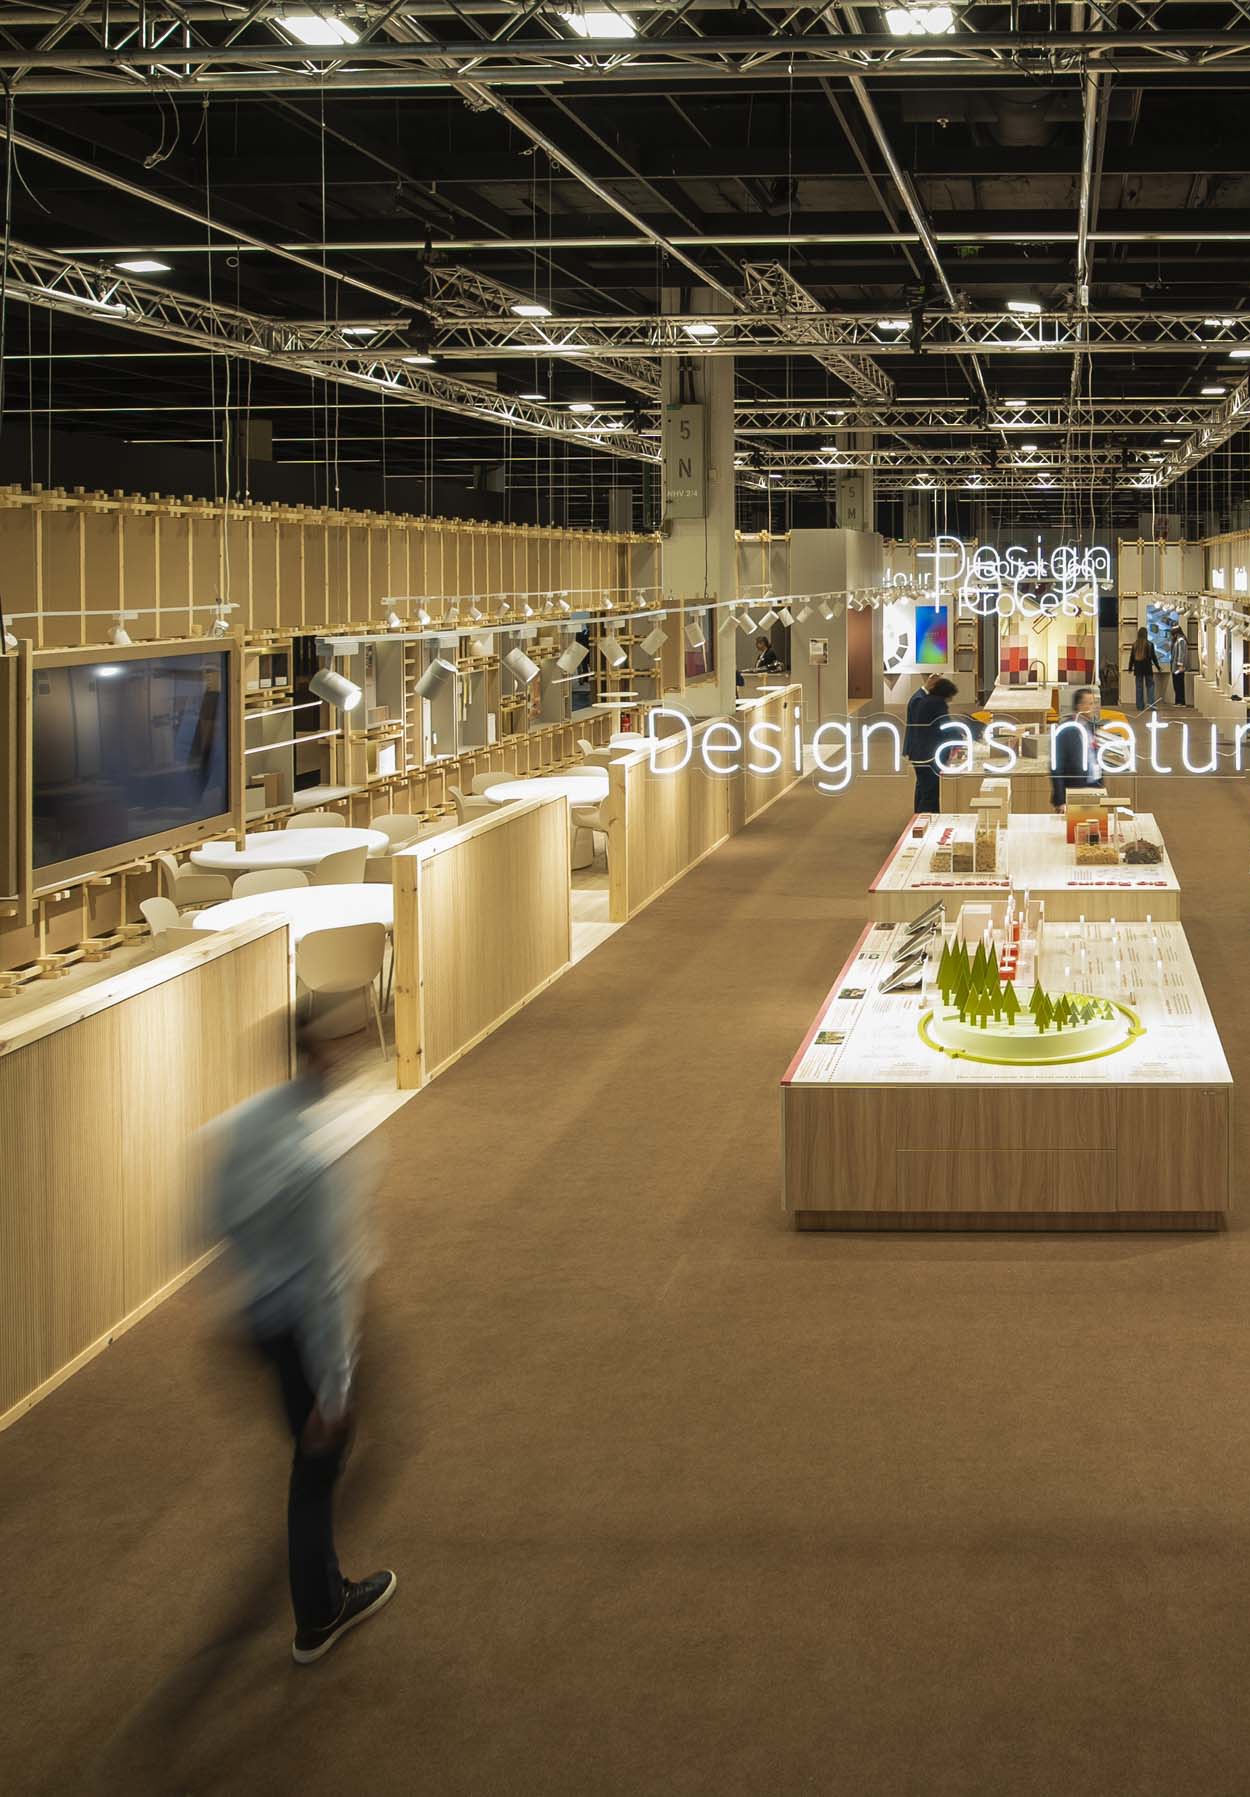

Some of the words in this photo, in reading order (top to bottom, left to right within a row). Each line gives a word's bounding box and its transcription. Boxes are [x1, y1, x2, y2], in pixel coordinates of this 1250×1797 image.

[680, 420, 691, 440] 5
[678, 458, 692, 478] N
[935, 535, 1112, 594] Design
[957, 585, 1099, 618] Process
[646, 706, 902, 792] Design
[936, 720, 1019, 775] as
